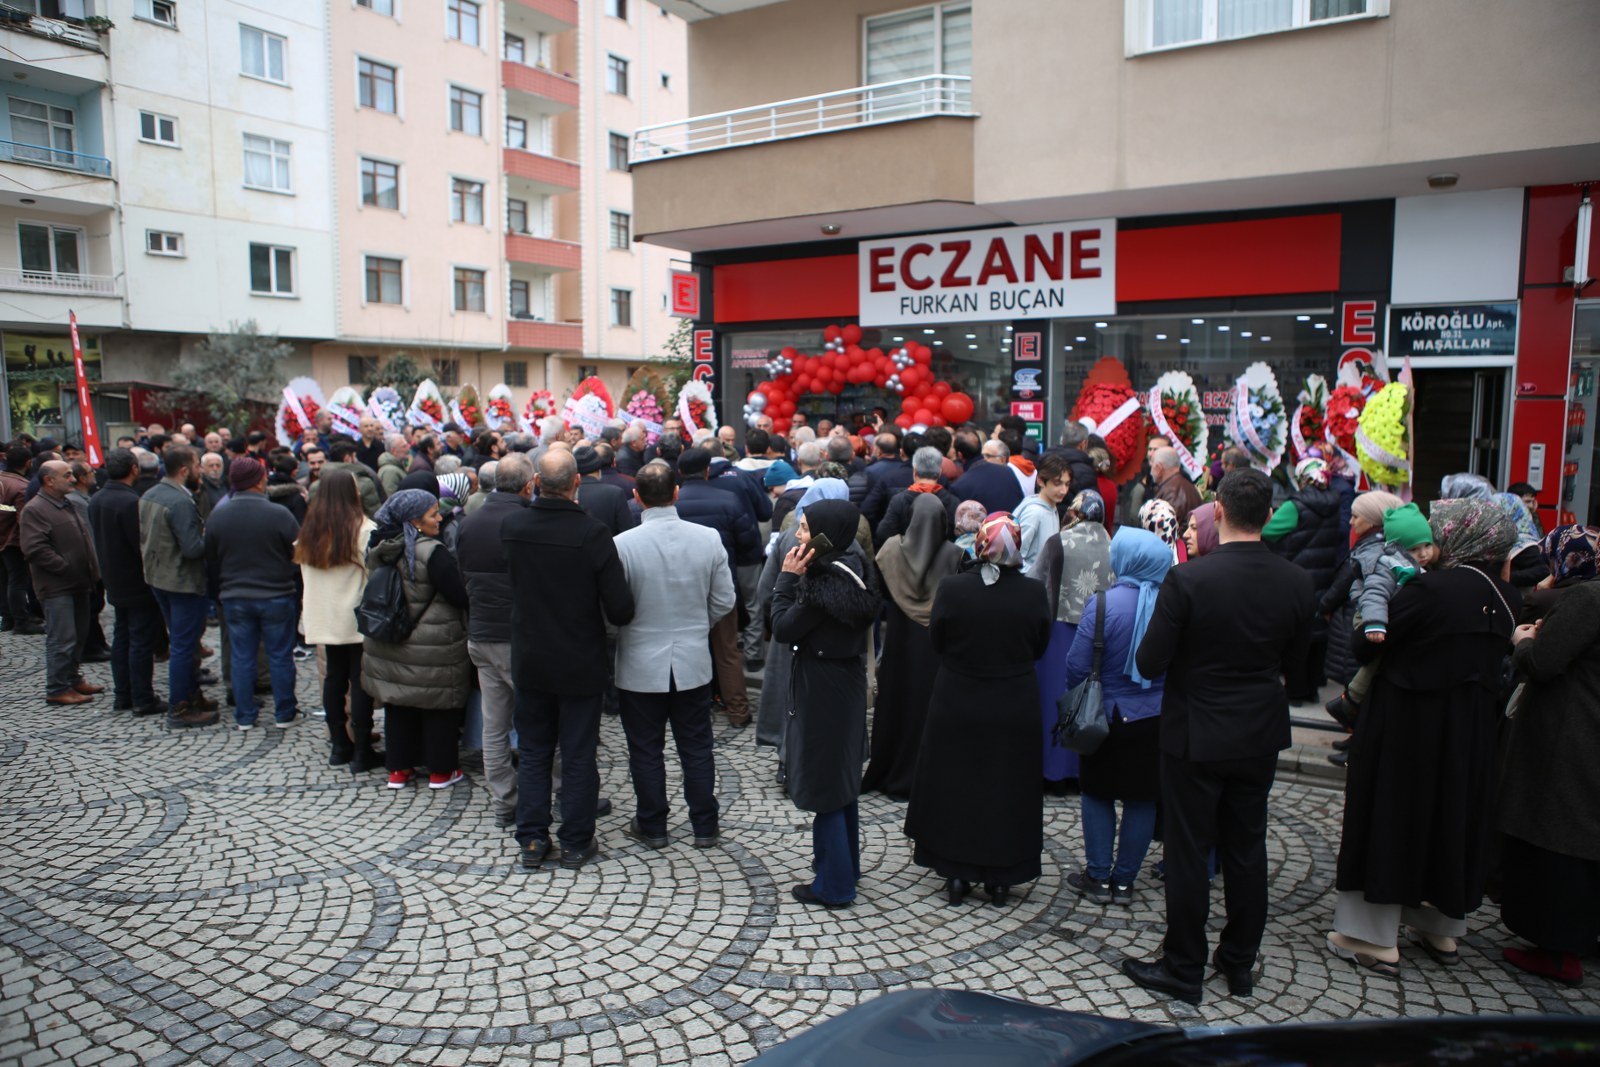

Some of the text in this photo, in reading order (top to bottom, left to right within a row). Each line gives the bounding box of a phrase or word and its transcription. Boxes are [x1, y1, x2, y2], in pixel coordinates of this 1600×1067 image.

[870, 229, 1102, 293] ECZANE
[900, 288, 1064, 315] FURKAN BUÇAN
[1401, 310, 1505, 331] KÖROĞLU Apt.
[1412, 339, 1491, 352] MAŞALLAH
